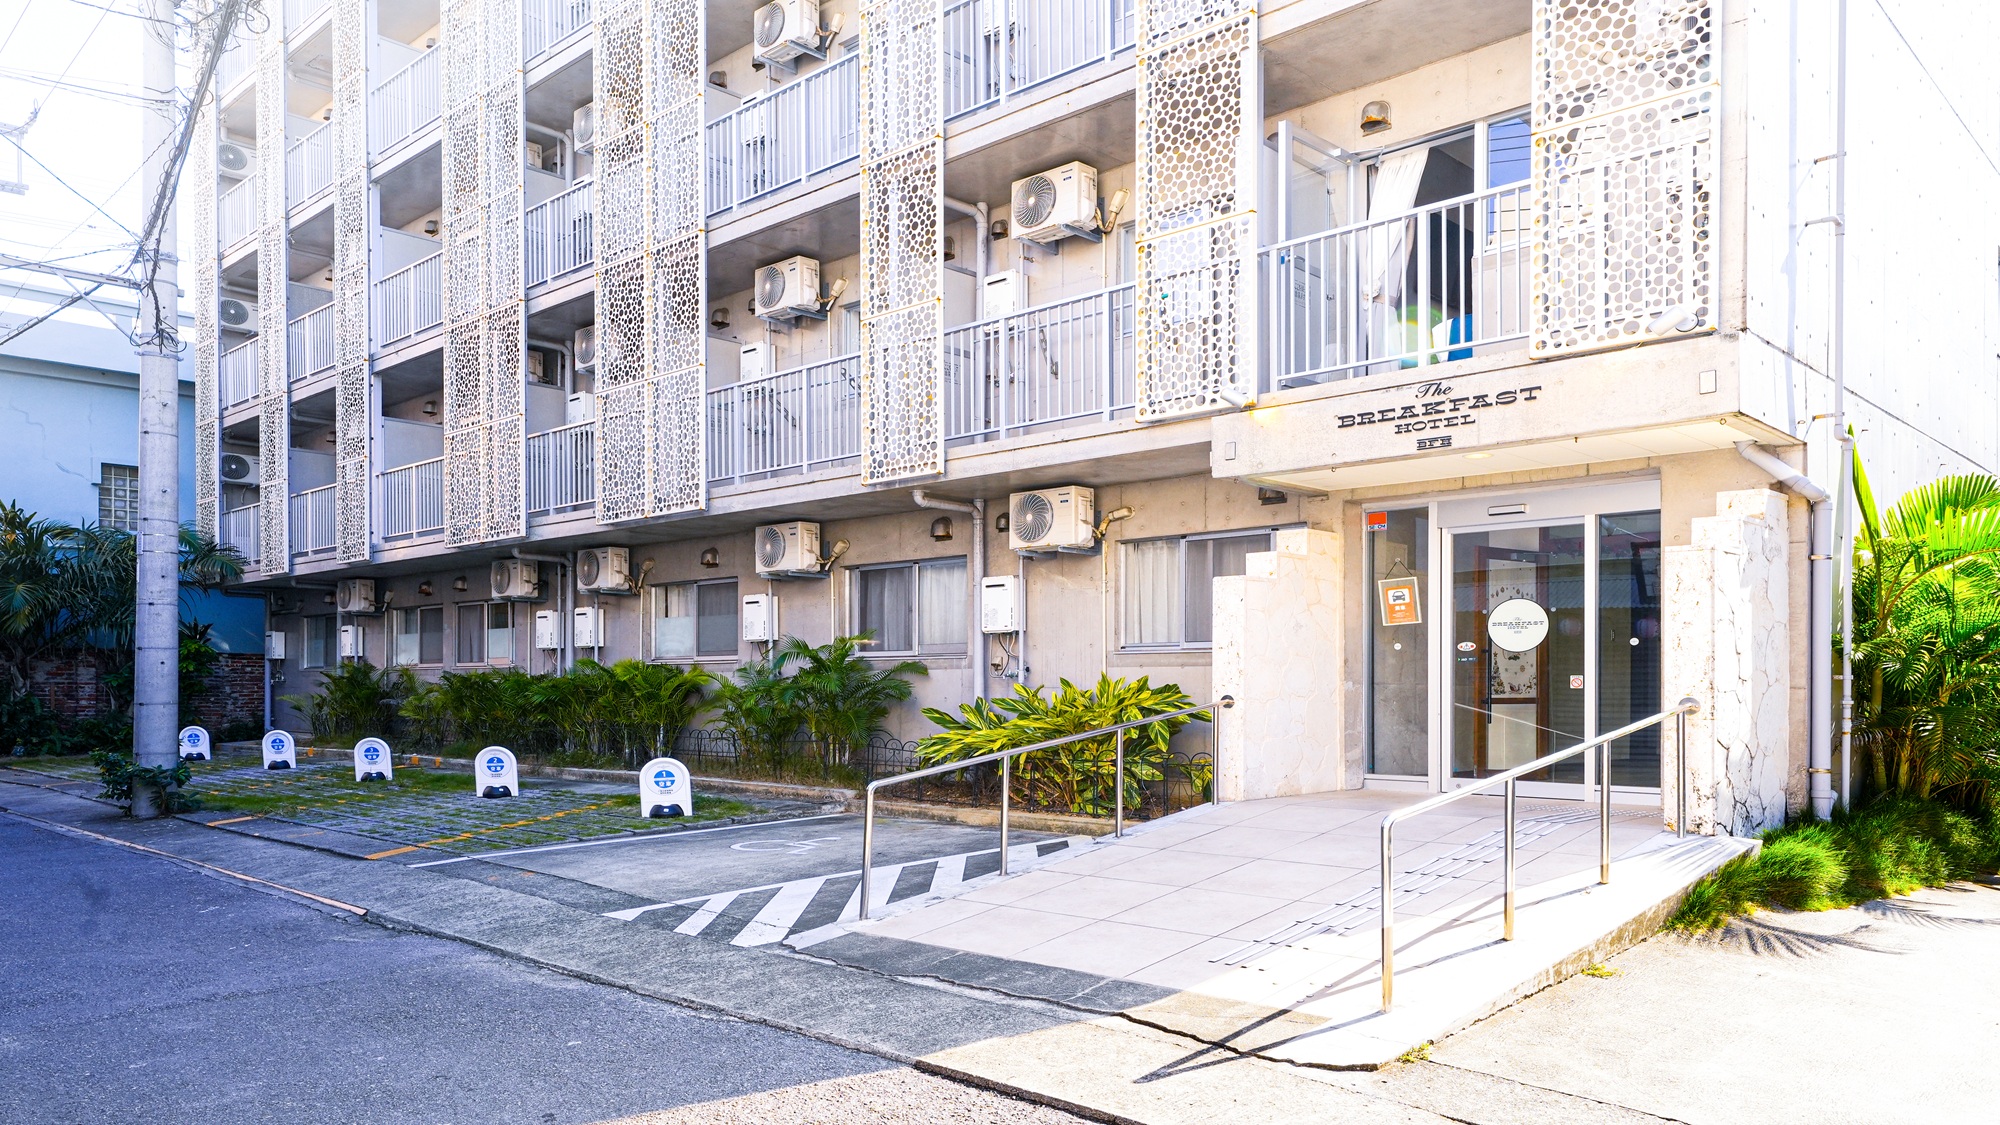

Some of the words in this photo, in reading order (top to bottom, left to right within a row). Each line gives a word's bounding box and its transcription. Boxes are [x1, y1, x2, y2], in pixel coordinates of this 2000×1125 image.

[1415, 382, 1454, 399] The
[1337, 385, 1542, 428] BREAKFAST
[1394, 414, 1476, 435] HOTEL
